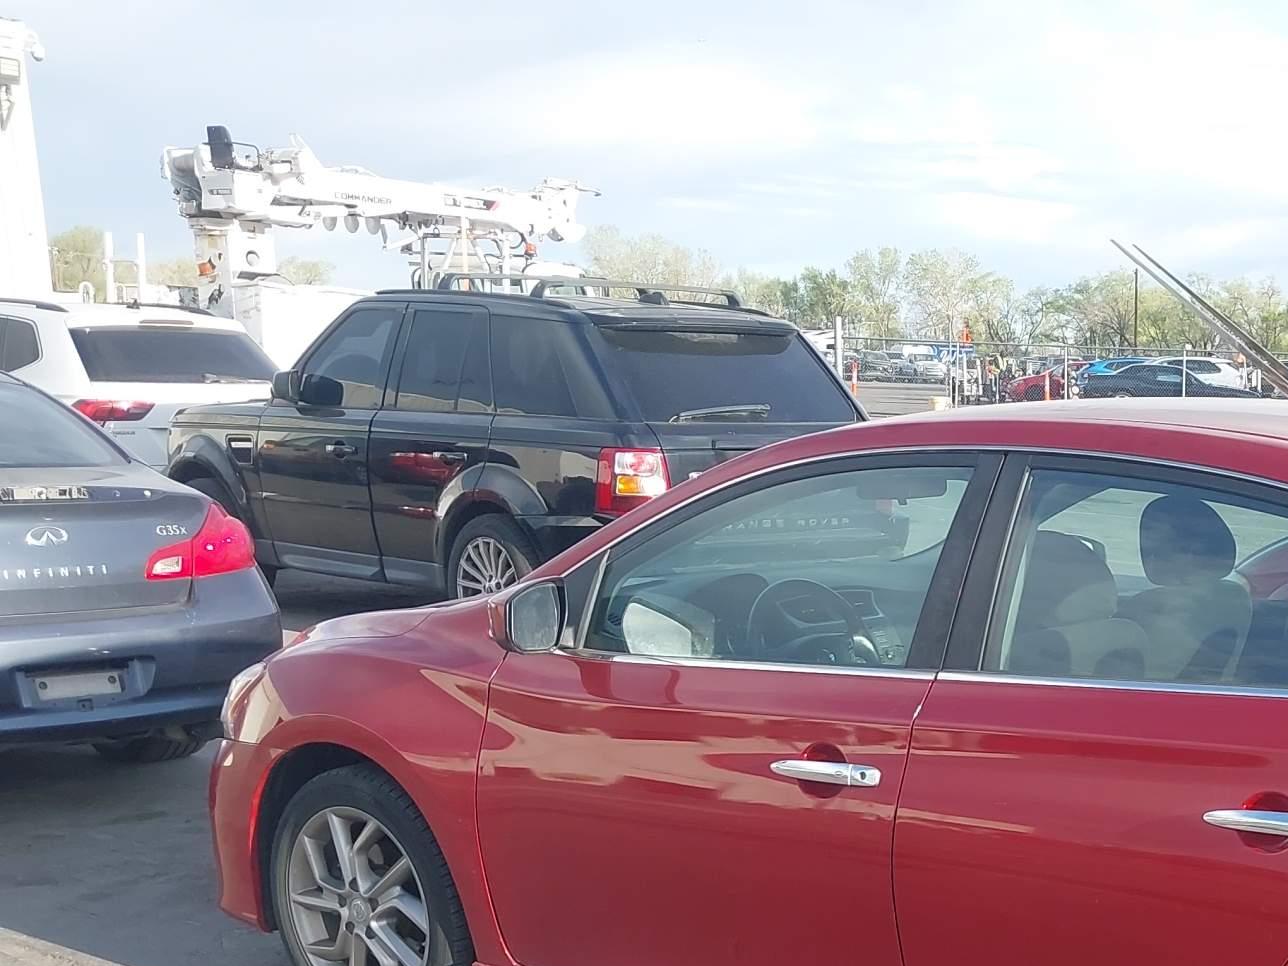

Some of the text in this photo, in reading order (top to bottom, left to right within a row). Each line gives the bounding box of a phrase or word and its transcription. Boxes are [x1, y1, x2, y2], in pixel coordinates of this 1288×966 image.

[334, 192, 392, 205] COMMANDER
[156, 524, 188, 536] G35x
[3, 564, 108, 580] INFINITI
